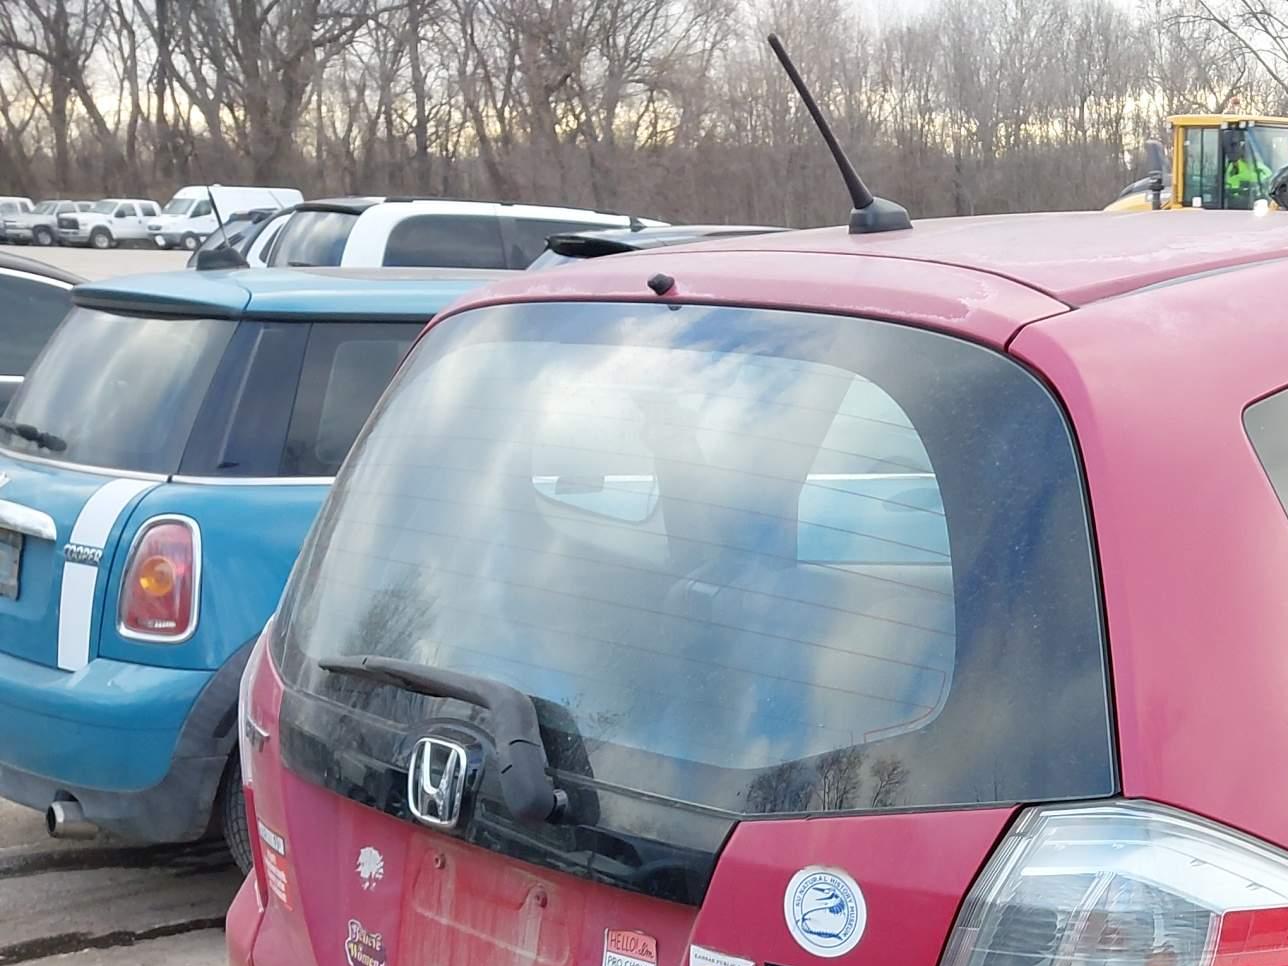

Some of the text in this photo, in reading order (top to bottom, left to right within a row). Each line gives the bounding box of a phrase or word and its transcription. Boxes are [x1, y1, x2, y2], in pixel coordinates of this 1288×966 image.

[64, 543, 103, 562] COOPER
[829, 876, 854, 904] HISTORY
[610, 932, 639, 954] HELLO!
